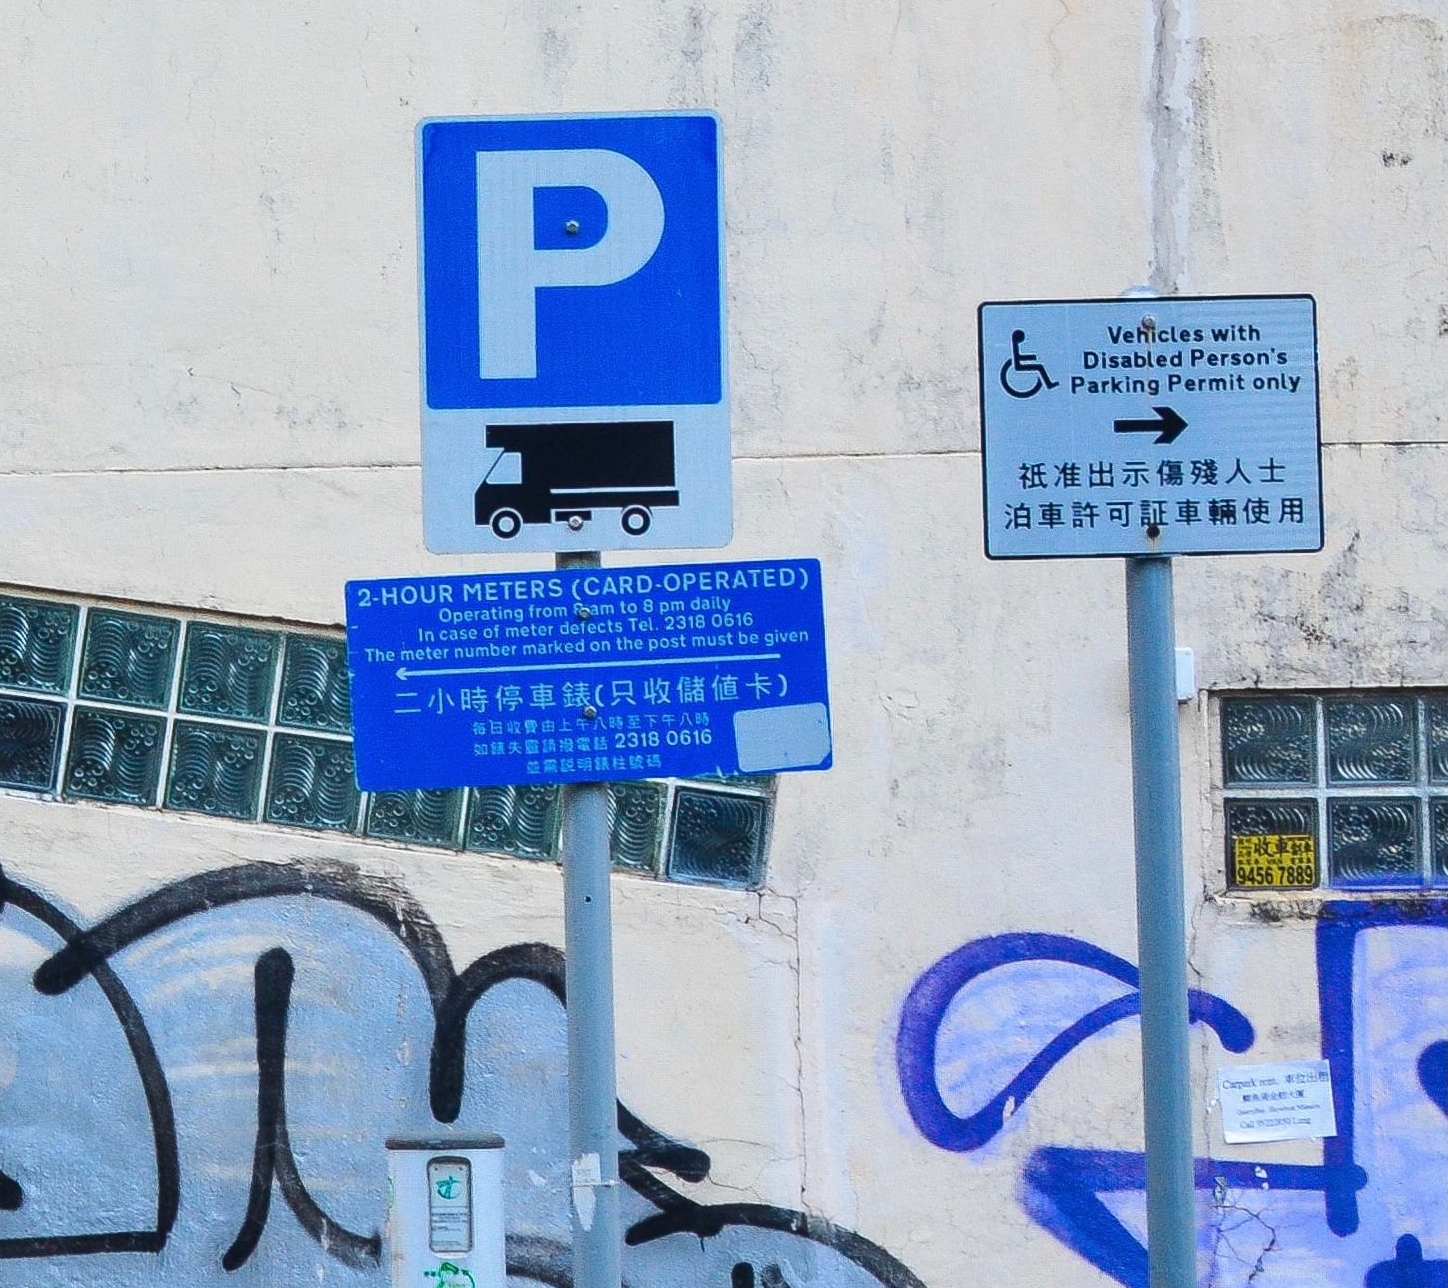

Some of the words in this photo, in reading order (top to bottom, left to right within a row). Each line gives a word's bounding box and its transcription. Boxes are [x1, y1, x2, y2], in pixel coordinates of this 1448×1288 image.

[475, 147, 666, 380] P
[1108, 323, 1204, 345] Vehicles
[1211, 324, 1261, 343] with
[1083, 350, 1183, 370] Disabled
[1190, 347, 1288, 367] Person's
[1071, 374, 1159, 396] Parking
[1167, 373, 1246, 393] Permit
[1253, 373, 1301, 394] only
[357, 584, 453, 607] 2-HOUR
[463, 578, 563, 602] METERS
[571, 567, 809, 601] (CARD-OPERATED)
[439, 607, 524, 624] Operating
[529, 604, 567, 619] from
[591, 604, 614, 616] am
[620, 601, 637, 614] to
[643, 598, 654, 613] 8
[659, 600, 685, 615] pm
[691, 596, 731, 612] daily
[418, 628, 435, 642] In
[439, 629, 477, 641] case
[483, 624, 501, 639] of
[505, 624, 554, 638] meter
[559, 618, 623, 635] defects
[628, 617, 659, 632] Tel.
[664, 615, 705, 631] 2318
[711, 612, 754, 628] 0616
[364, 648, 395, 663] The
[400, 646, 449, 661] meter
[454, 642, 517, 659] number
[522, 639, 585, 655] marked
[590, 640, 611, 652] on
[616, 636, 644, 651] the
[648, 634, 687, 652] post
[691, 632, 734, 648] must
[738, 629, 759, 645] be
[764, 629, 809, 647] given
[614, 732, 661, 749] 2318
[666, 729, 712, 746] 0616
[1237, 866, 1273, 885] 9456
[1278, 865, 1313, 885] 7889
